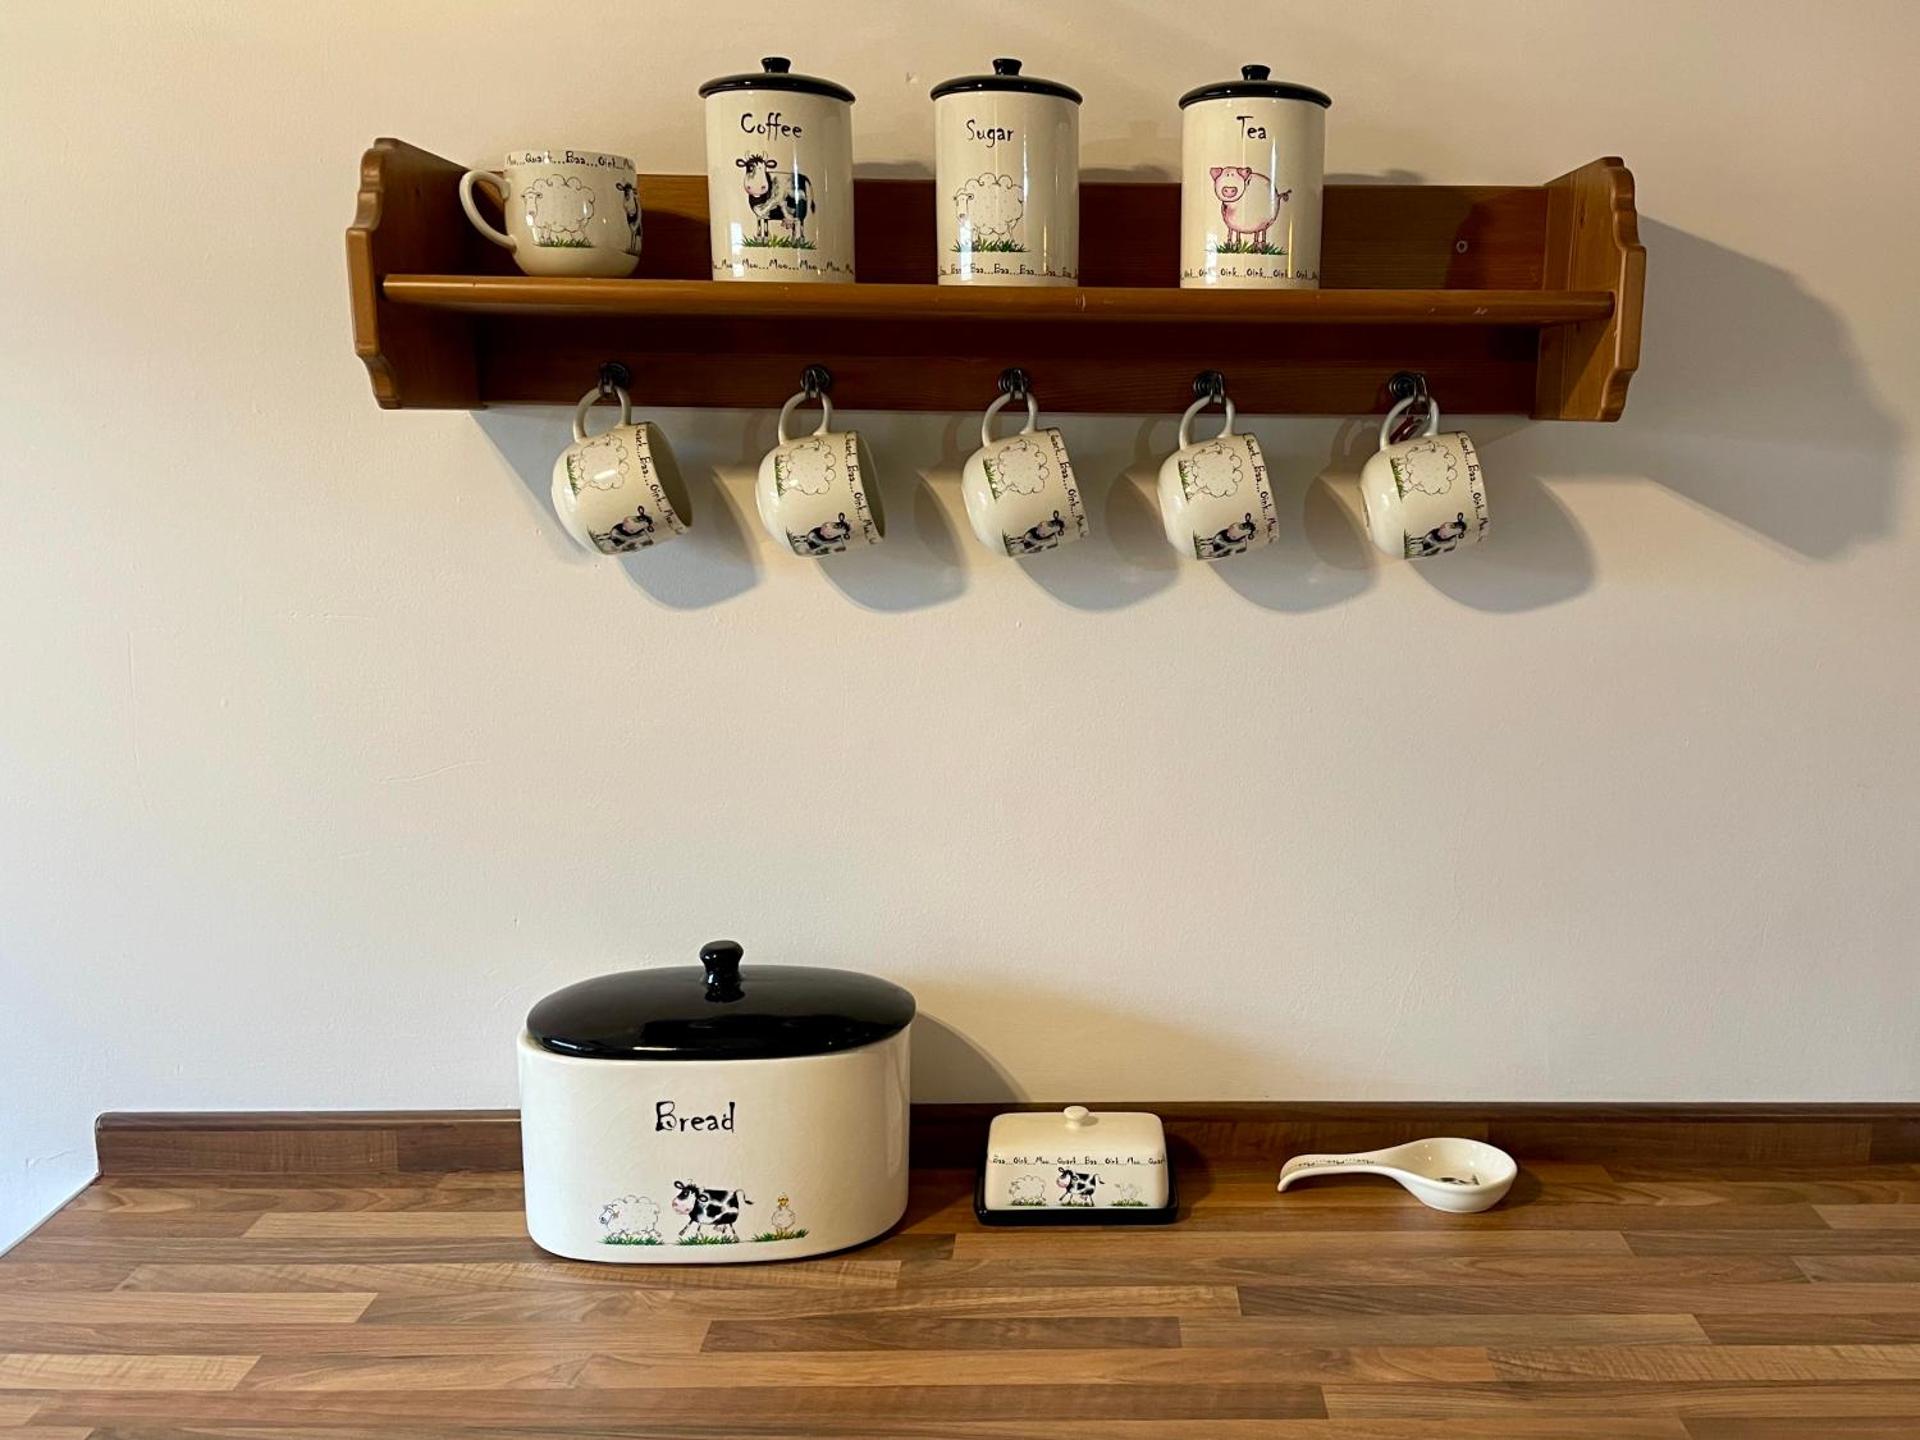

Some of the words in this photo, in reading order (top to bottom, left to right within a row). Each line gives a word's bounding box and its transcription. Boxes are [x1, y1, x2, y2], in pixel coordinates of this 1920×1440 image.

[740, 112, 803, 141] Coffee
[966, 119, 1015, 148] Sugar
[1236, 115, 1268, 140] Tea
[655, 1101, 736, 1134] Bread
